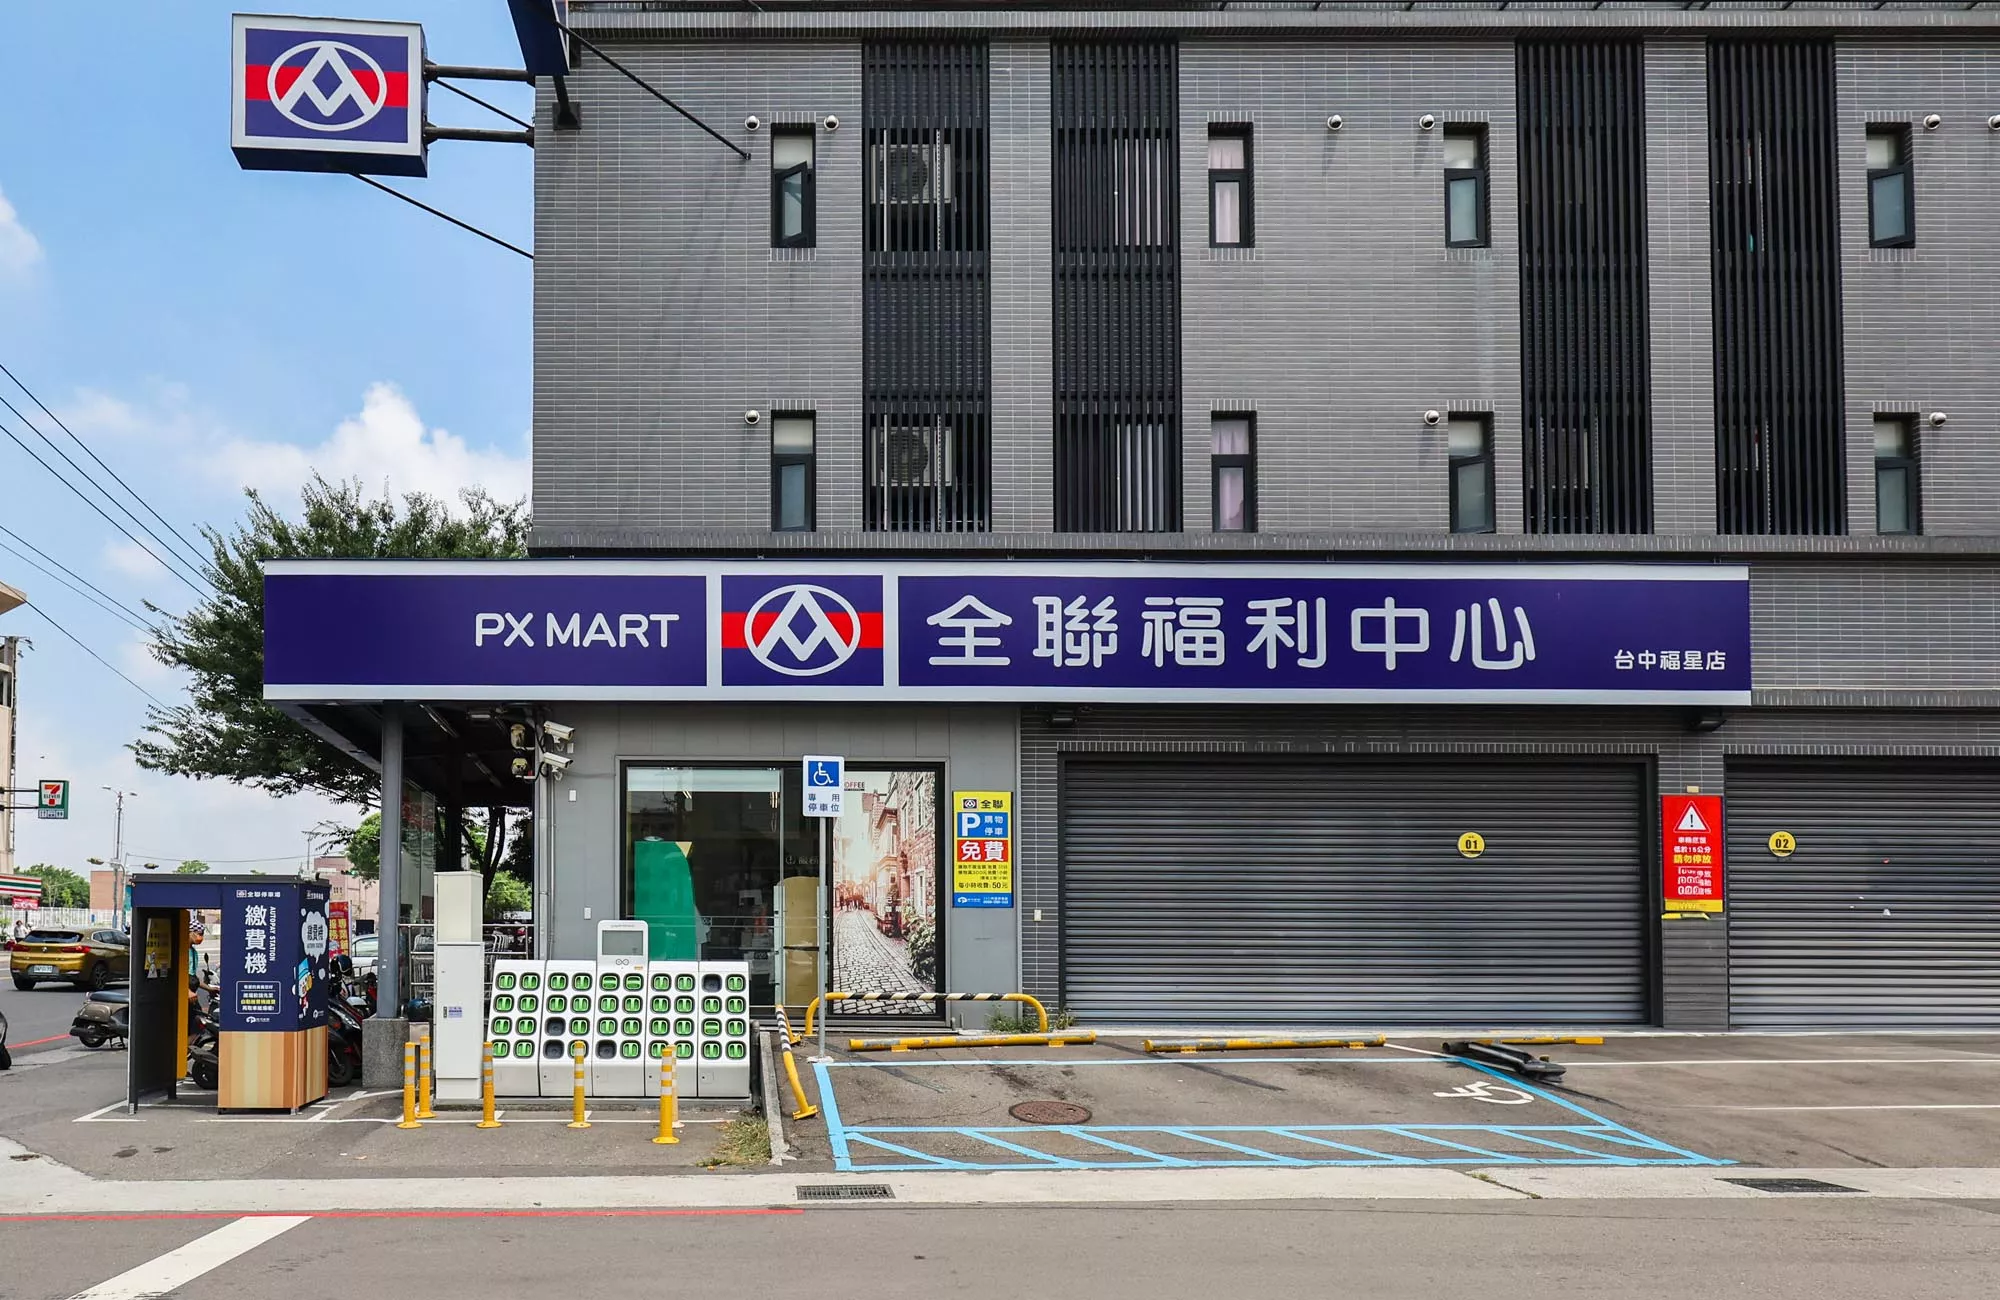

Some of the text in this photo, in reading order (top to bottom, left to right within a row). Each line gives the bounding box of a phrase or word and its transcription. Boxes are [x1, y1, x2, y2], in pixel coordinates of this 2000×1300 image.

[475, 612, 680, 648] PX MART
[926, 594, 1536, 671] 全聯福利中心
[1614, 649, 1727, 671] 台中福星店
[808, 793, 840, 802] 專用
[808, 803, 840, 812] 停車位
[962, 813, 981, 837] P
[961, 840, 1005, 862] 免費
[1465, 839, 1478, 850] 01
[1775, 838, 1789, 849] 02
[1673, 854, 1712, 864] 請勿停放
[269, 906, 277, 935] AUTOPAY
[244, 904, 267, 975] 繳費機
